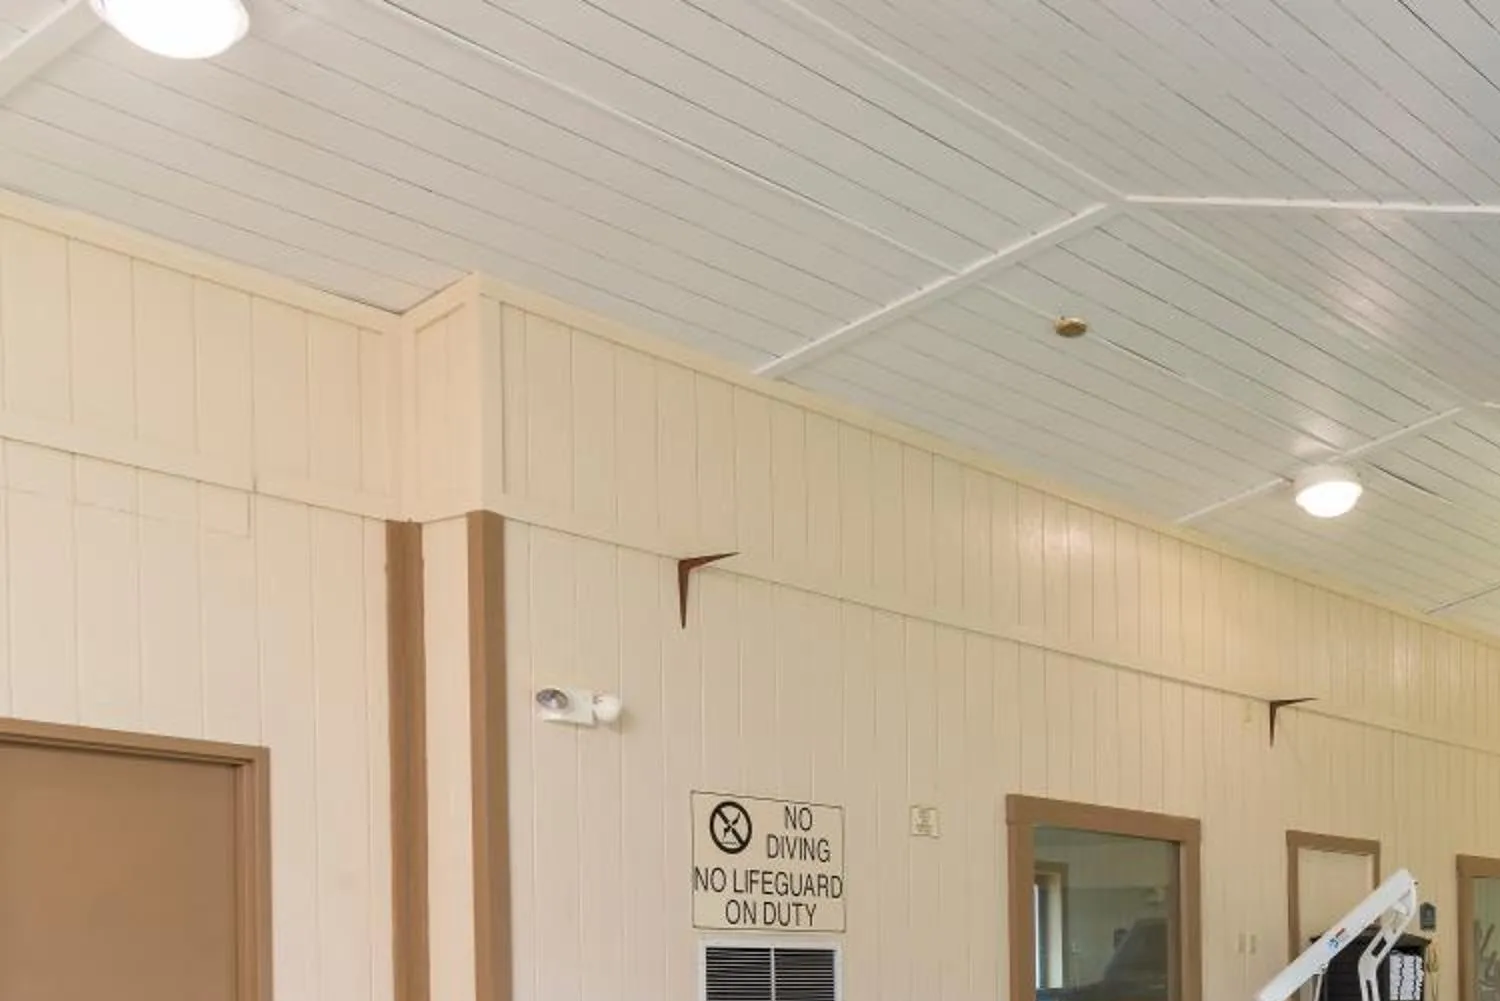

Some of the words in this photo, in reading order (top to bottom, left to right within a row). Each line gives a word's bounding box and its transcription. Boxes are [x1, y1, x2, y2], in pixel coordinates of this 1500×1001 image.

[784, 805, 813, 831] NO
[766, 834, 831, 862] DIVING
[694, 866, 727, 893] NO
[733, 868, 843, 899] LIFEGUARD
[725, 899, 757, 925] ON
[763, 901, 817, 927] DUTY
